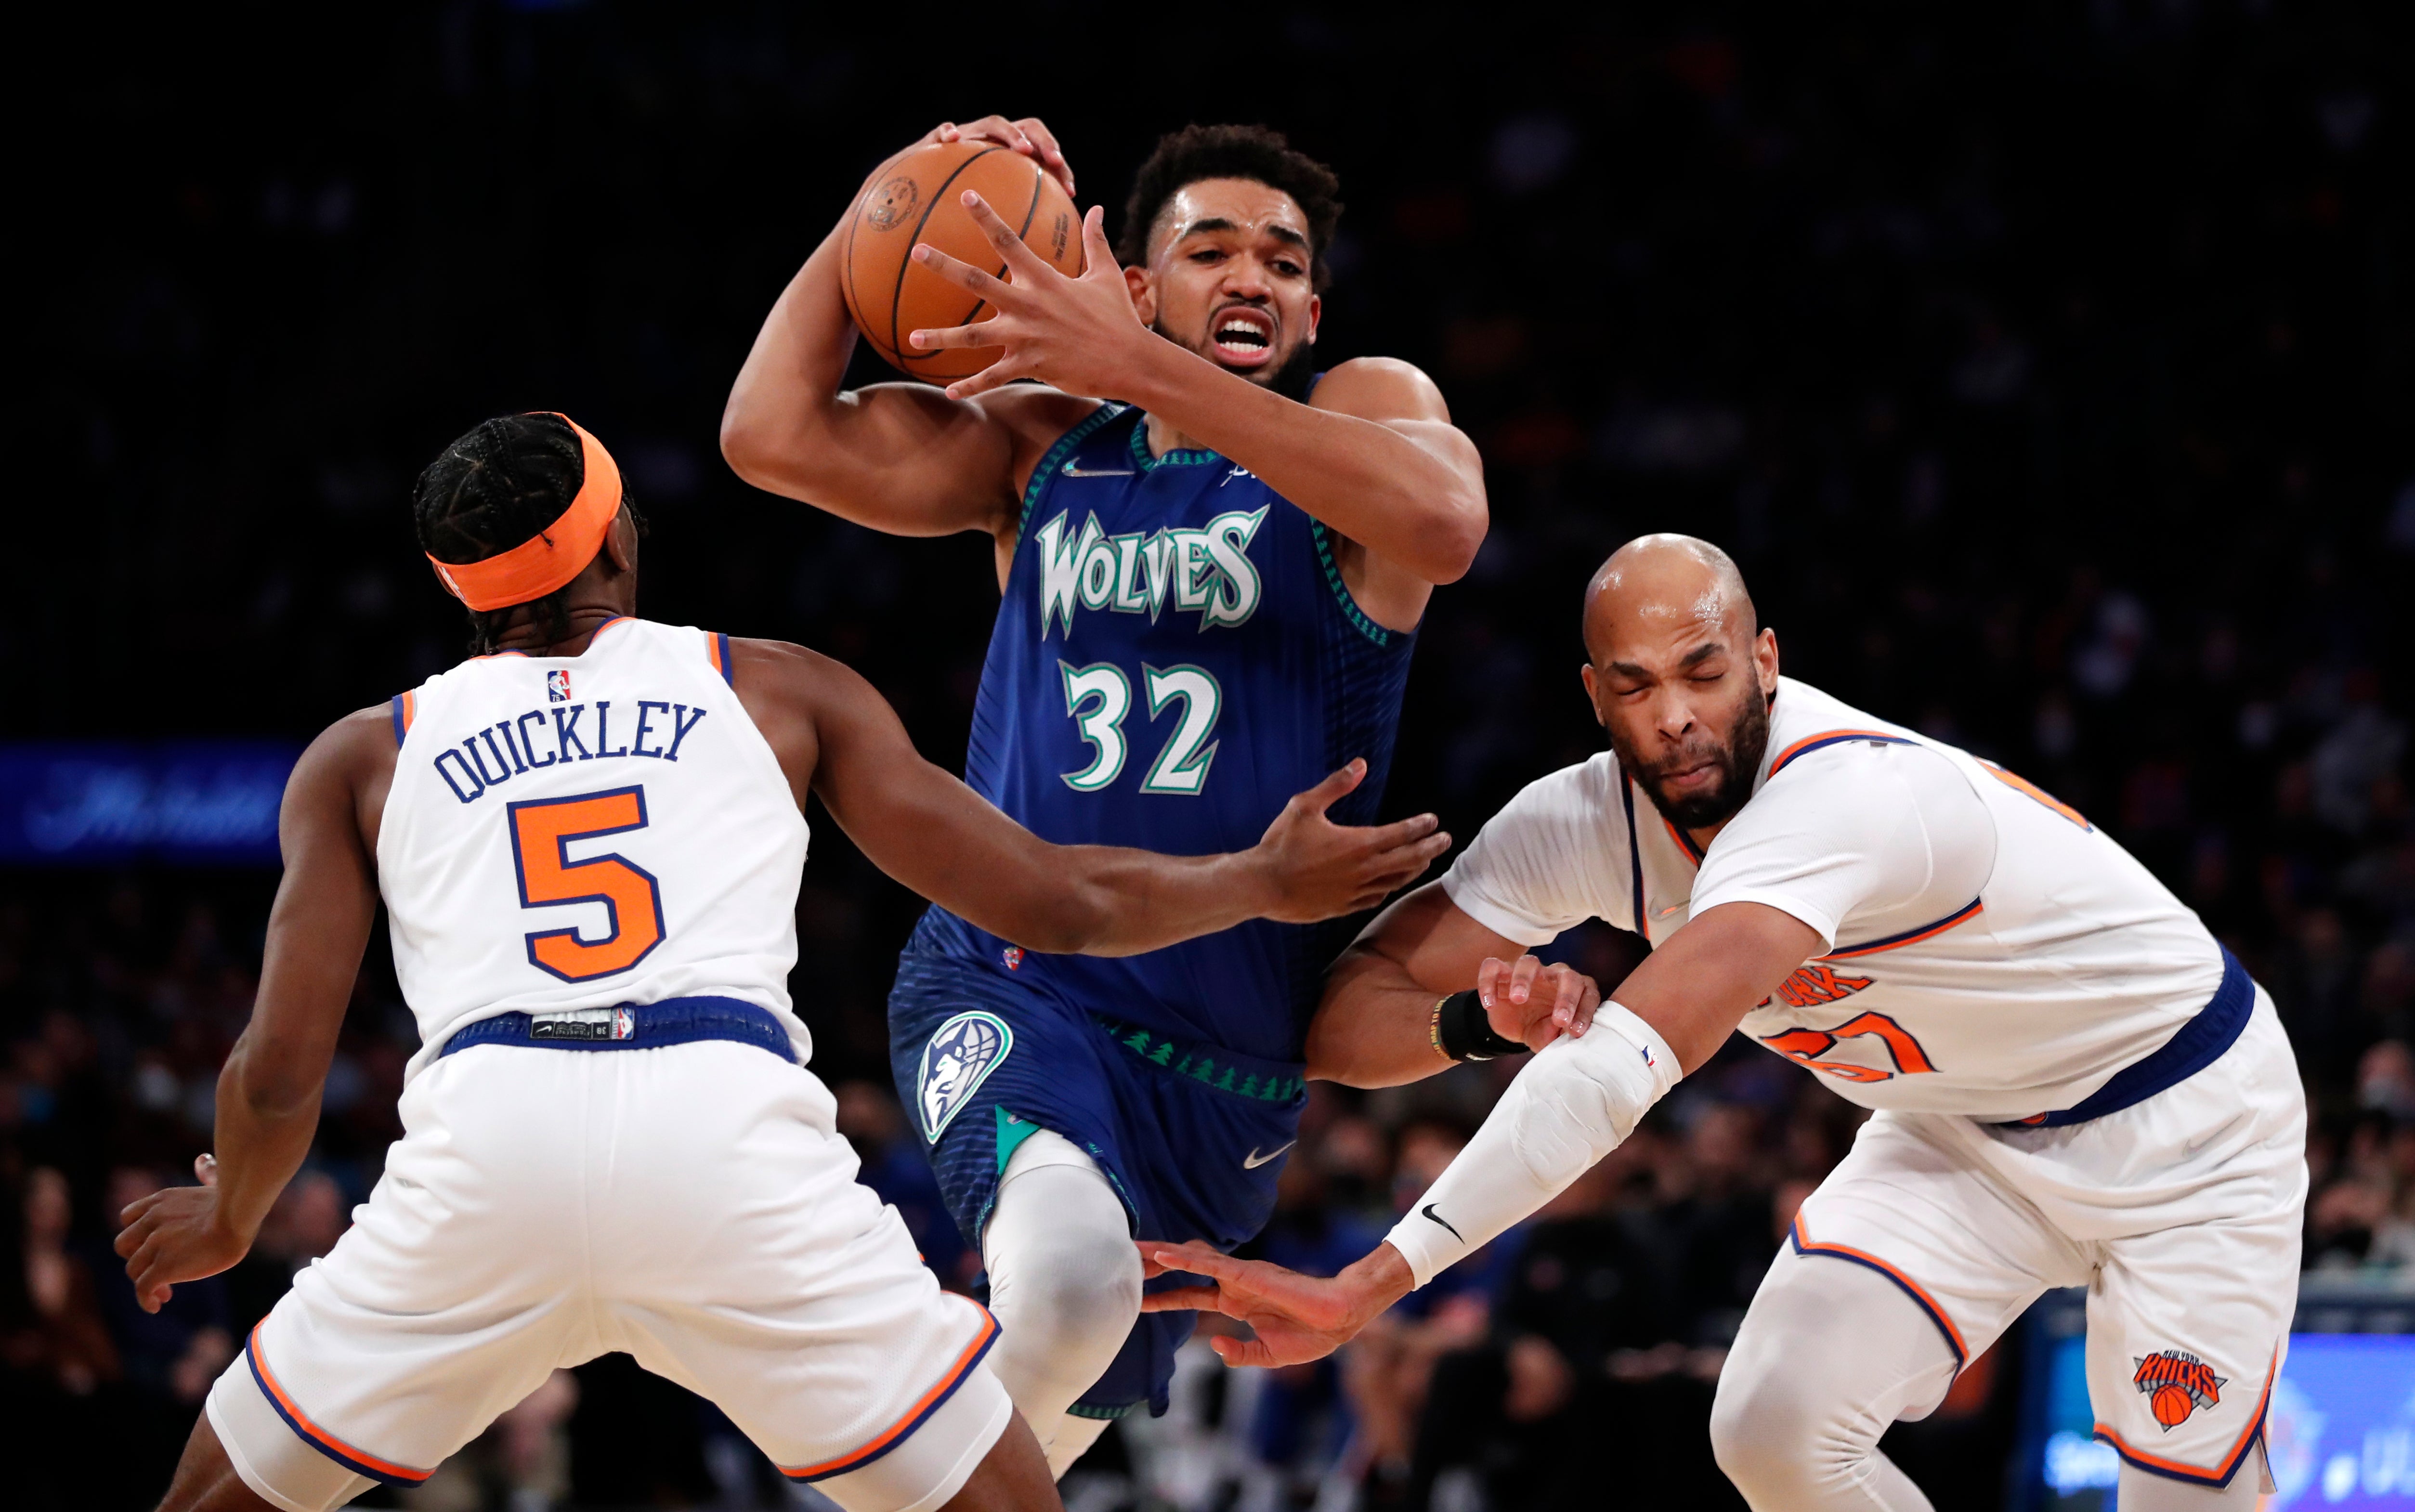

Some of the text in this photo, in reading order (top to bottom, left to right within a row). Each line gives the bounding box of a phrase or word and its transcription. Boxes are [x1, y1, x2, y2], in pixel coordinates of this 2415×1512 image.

[1034, 504, 1270, 642] WOLVES
[551, 694, 560, 702] 75
[1057, 658, 1222, 796] 32
[433, 701, 707, 804] QUICKLEY
[506, 784, 667, 984] 5
[2133, 1353, 2219, 1403] KNICKS
[2162, 1350, 2200, 1366] NEW YORK
